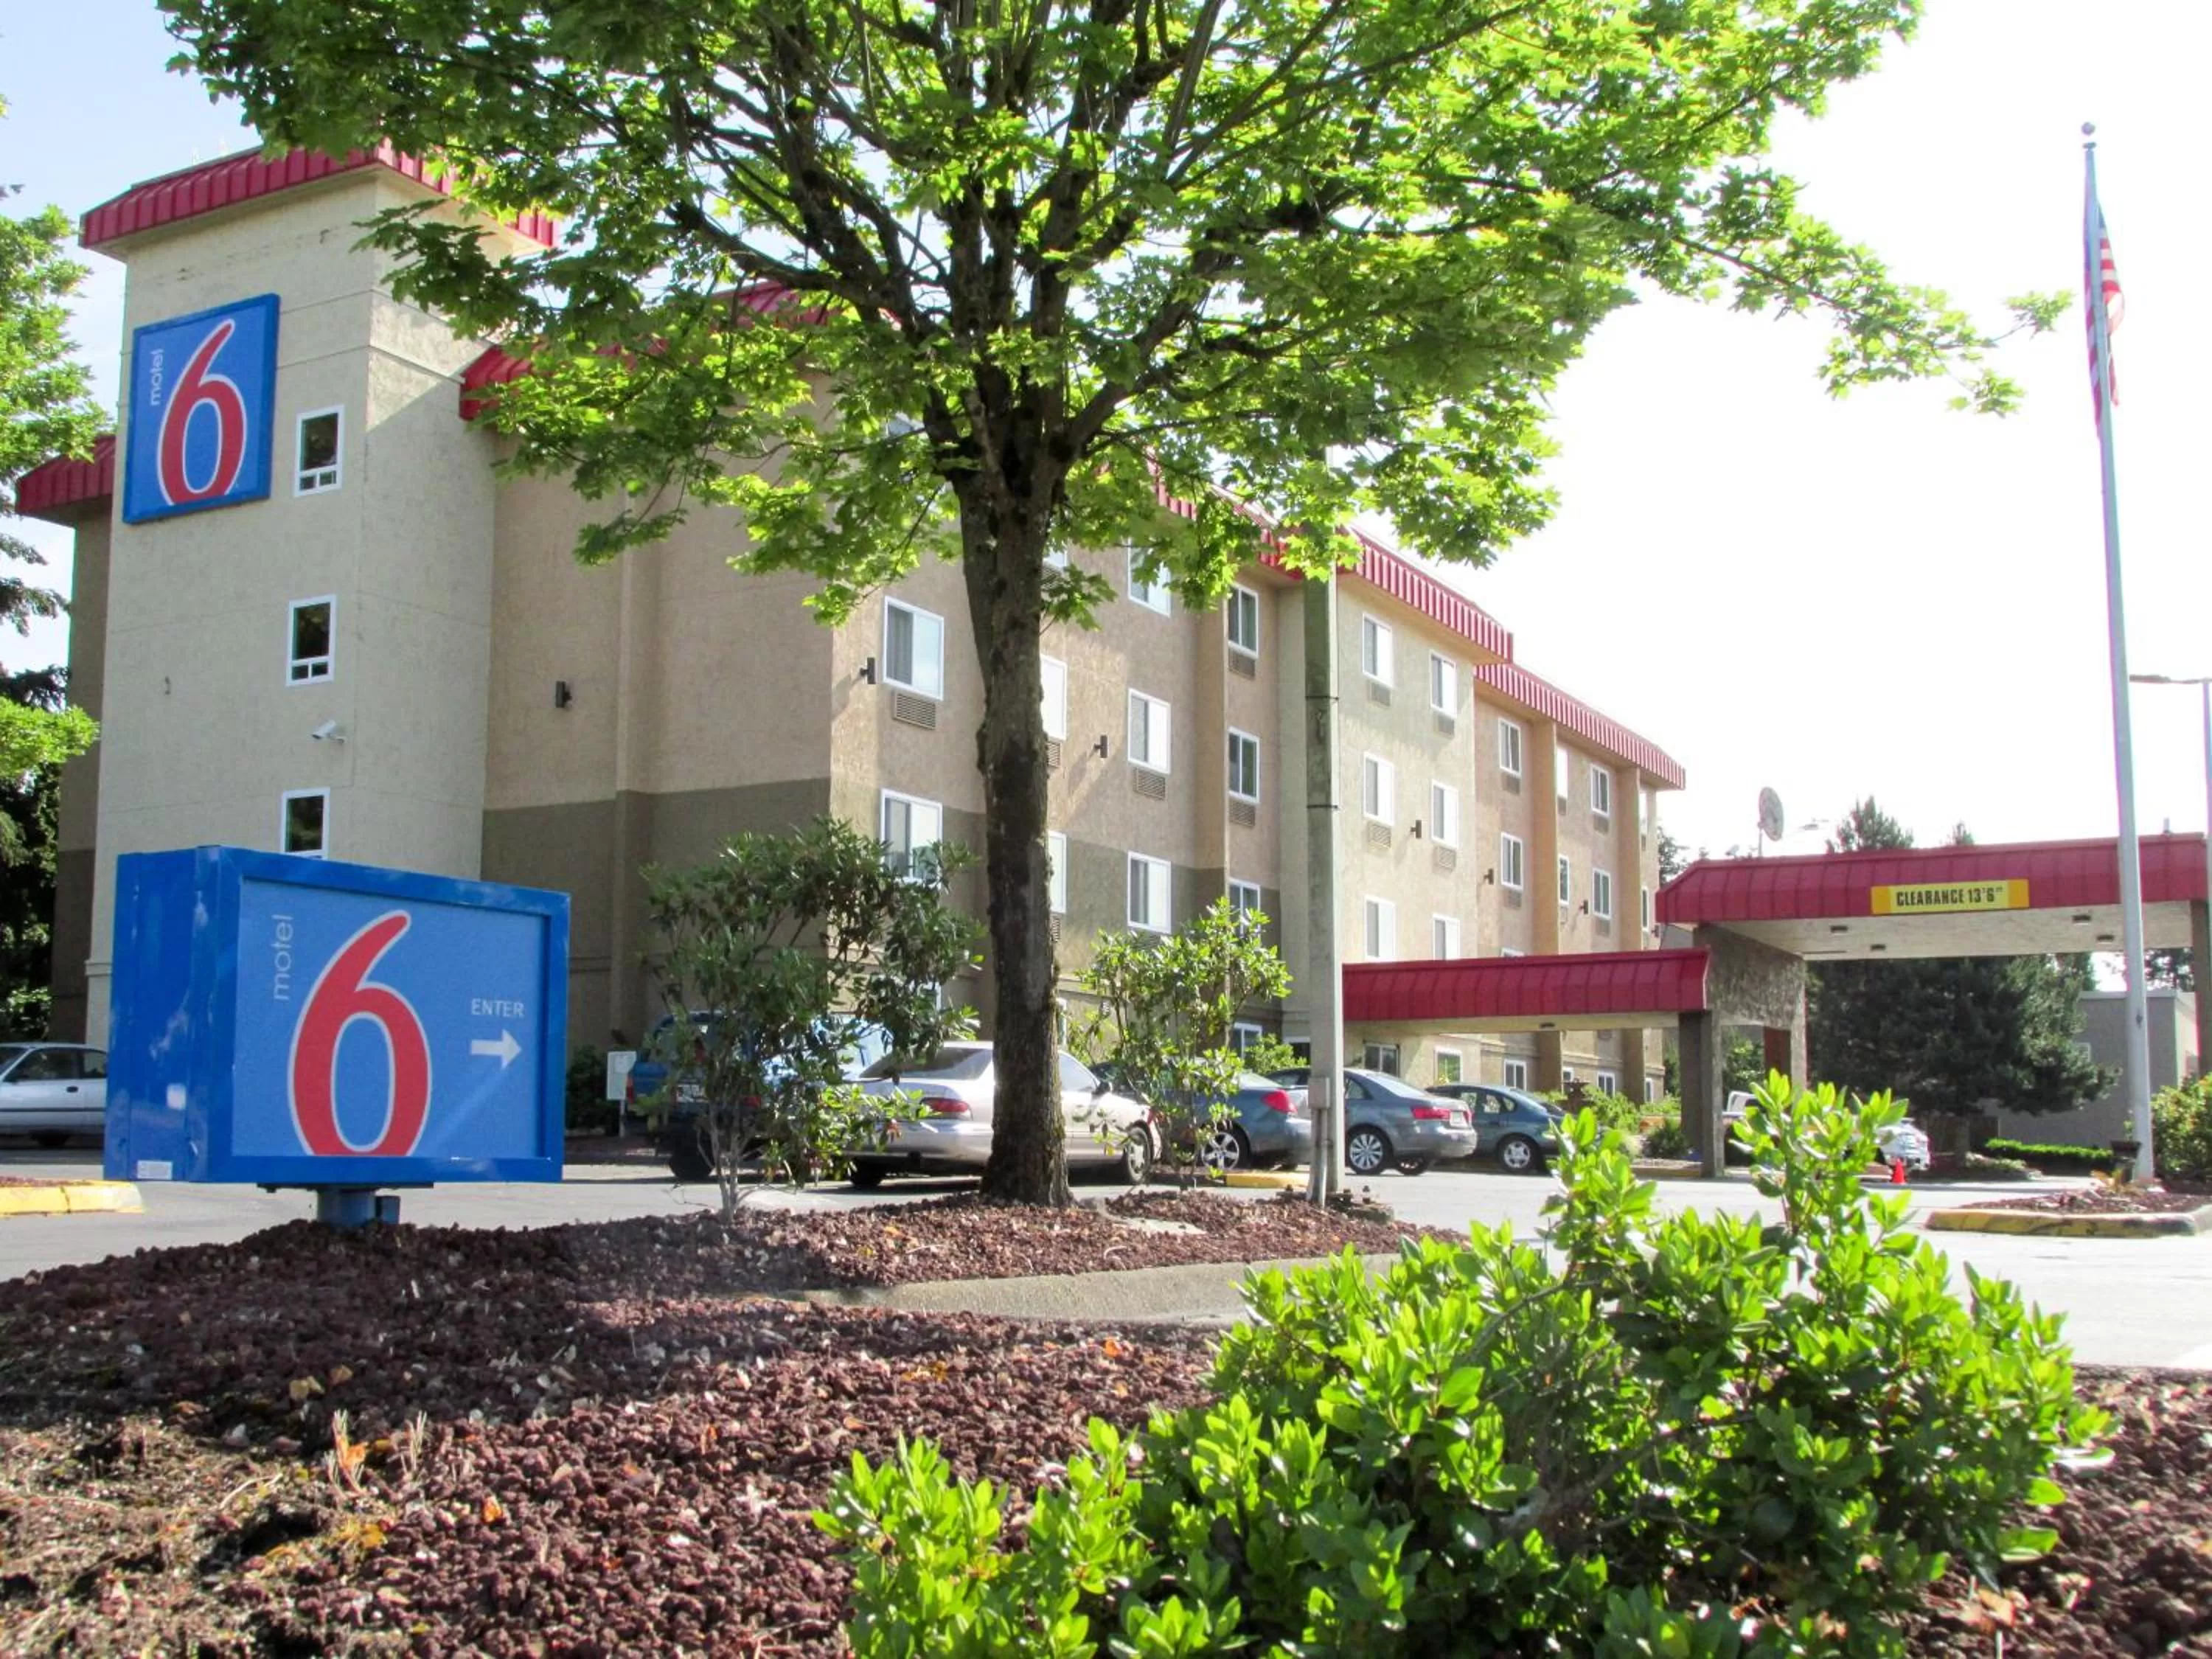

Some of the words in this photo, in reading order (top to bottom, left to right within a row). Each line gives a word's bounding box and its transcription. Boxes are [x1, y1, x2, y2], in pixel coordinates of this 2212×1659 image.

[150, 348, 164, 406] motel
[157, 319, 247, 506] 6
[1896, 888, 1964, 906] CLEARANCE
[273, 914, 293, 1001] motel
[288, 910, 432, 1157] 6
[470, 998, 525, 1018] ENTER
